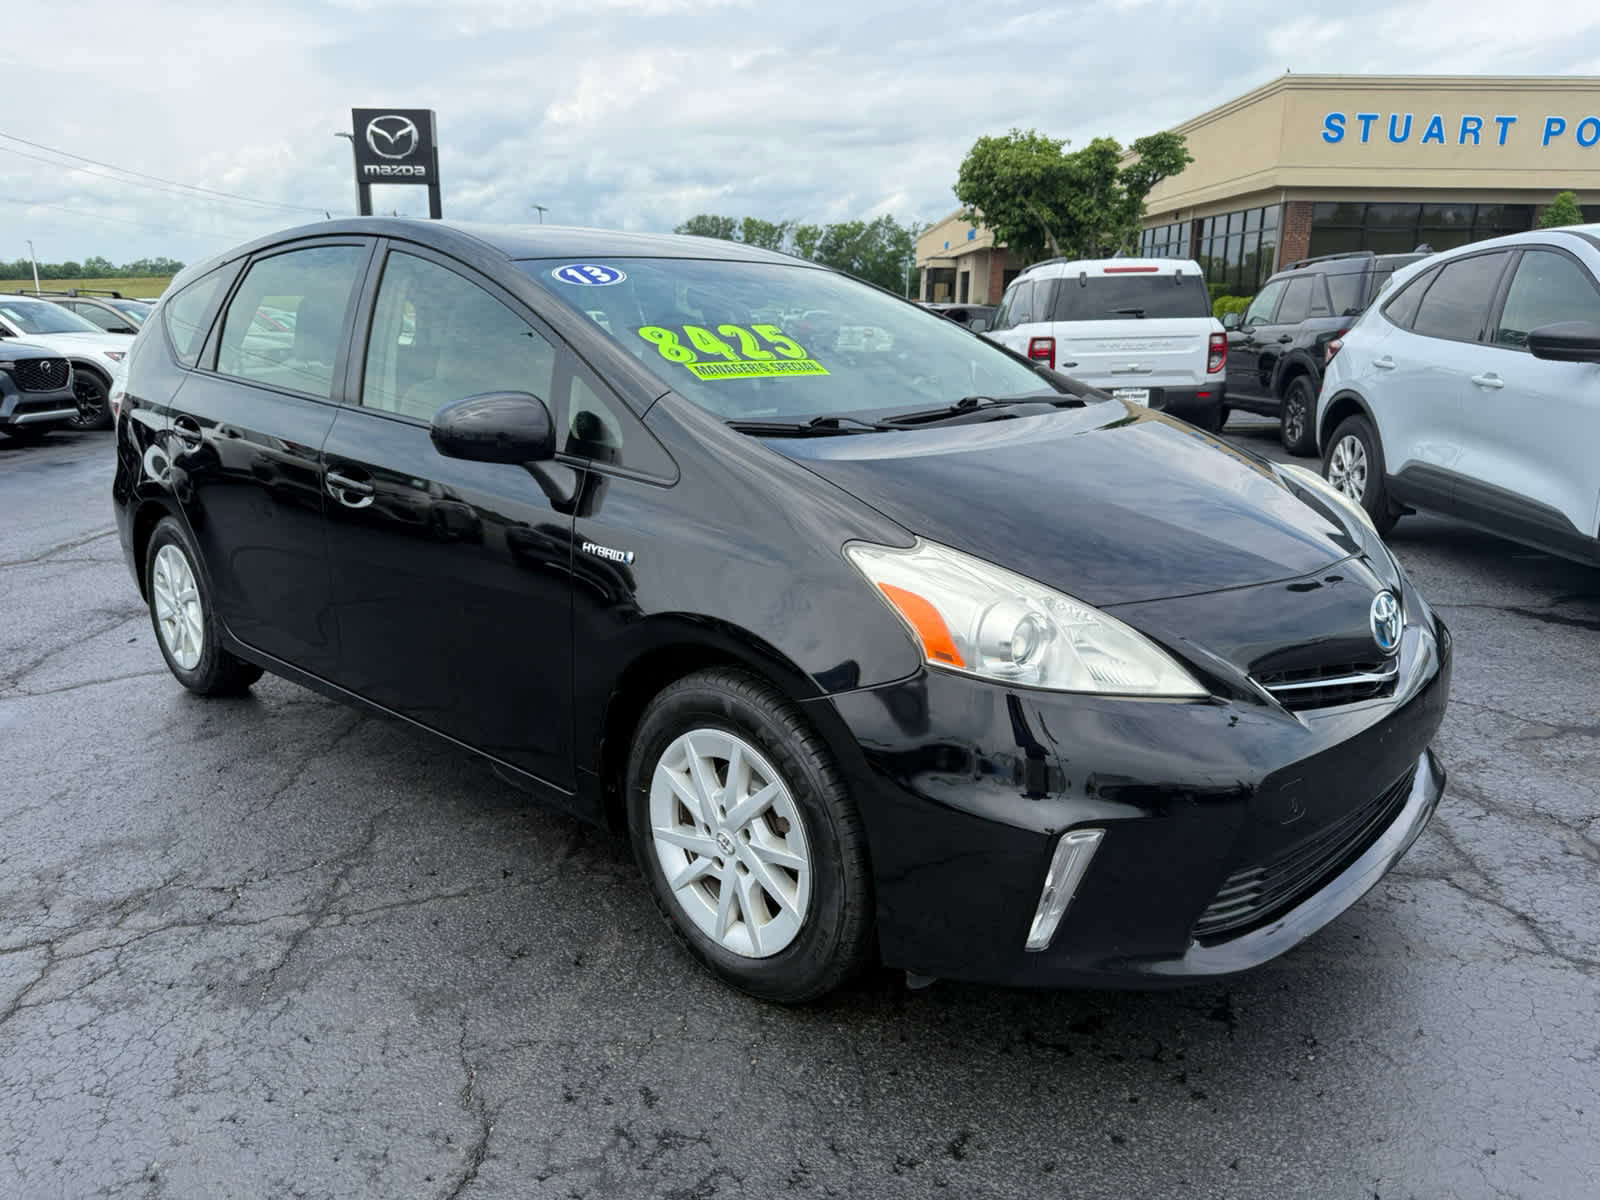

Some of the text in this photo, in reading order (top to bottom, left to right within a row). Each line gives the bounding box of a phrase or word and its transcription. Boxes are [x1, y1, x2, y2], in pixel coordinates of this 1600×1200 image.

[1321, 112, 1518, 146] STUART
[565, 265, 611, 284] 13
[638, 324, 808, 364] 8425
[694, 361, 821, 376] MANAGER'S SPECIAL
[582, 542, 625, 562] HYBRID
